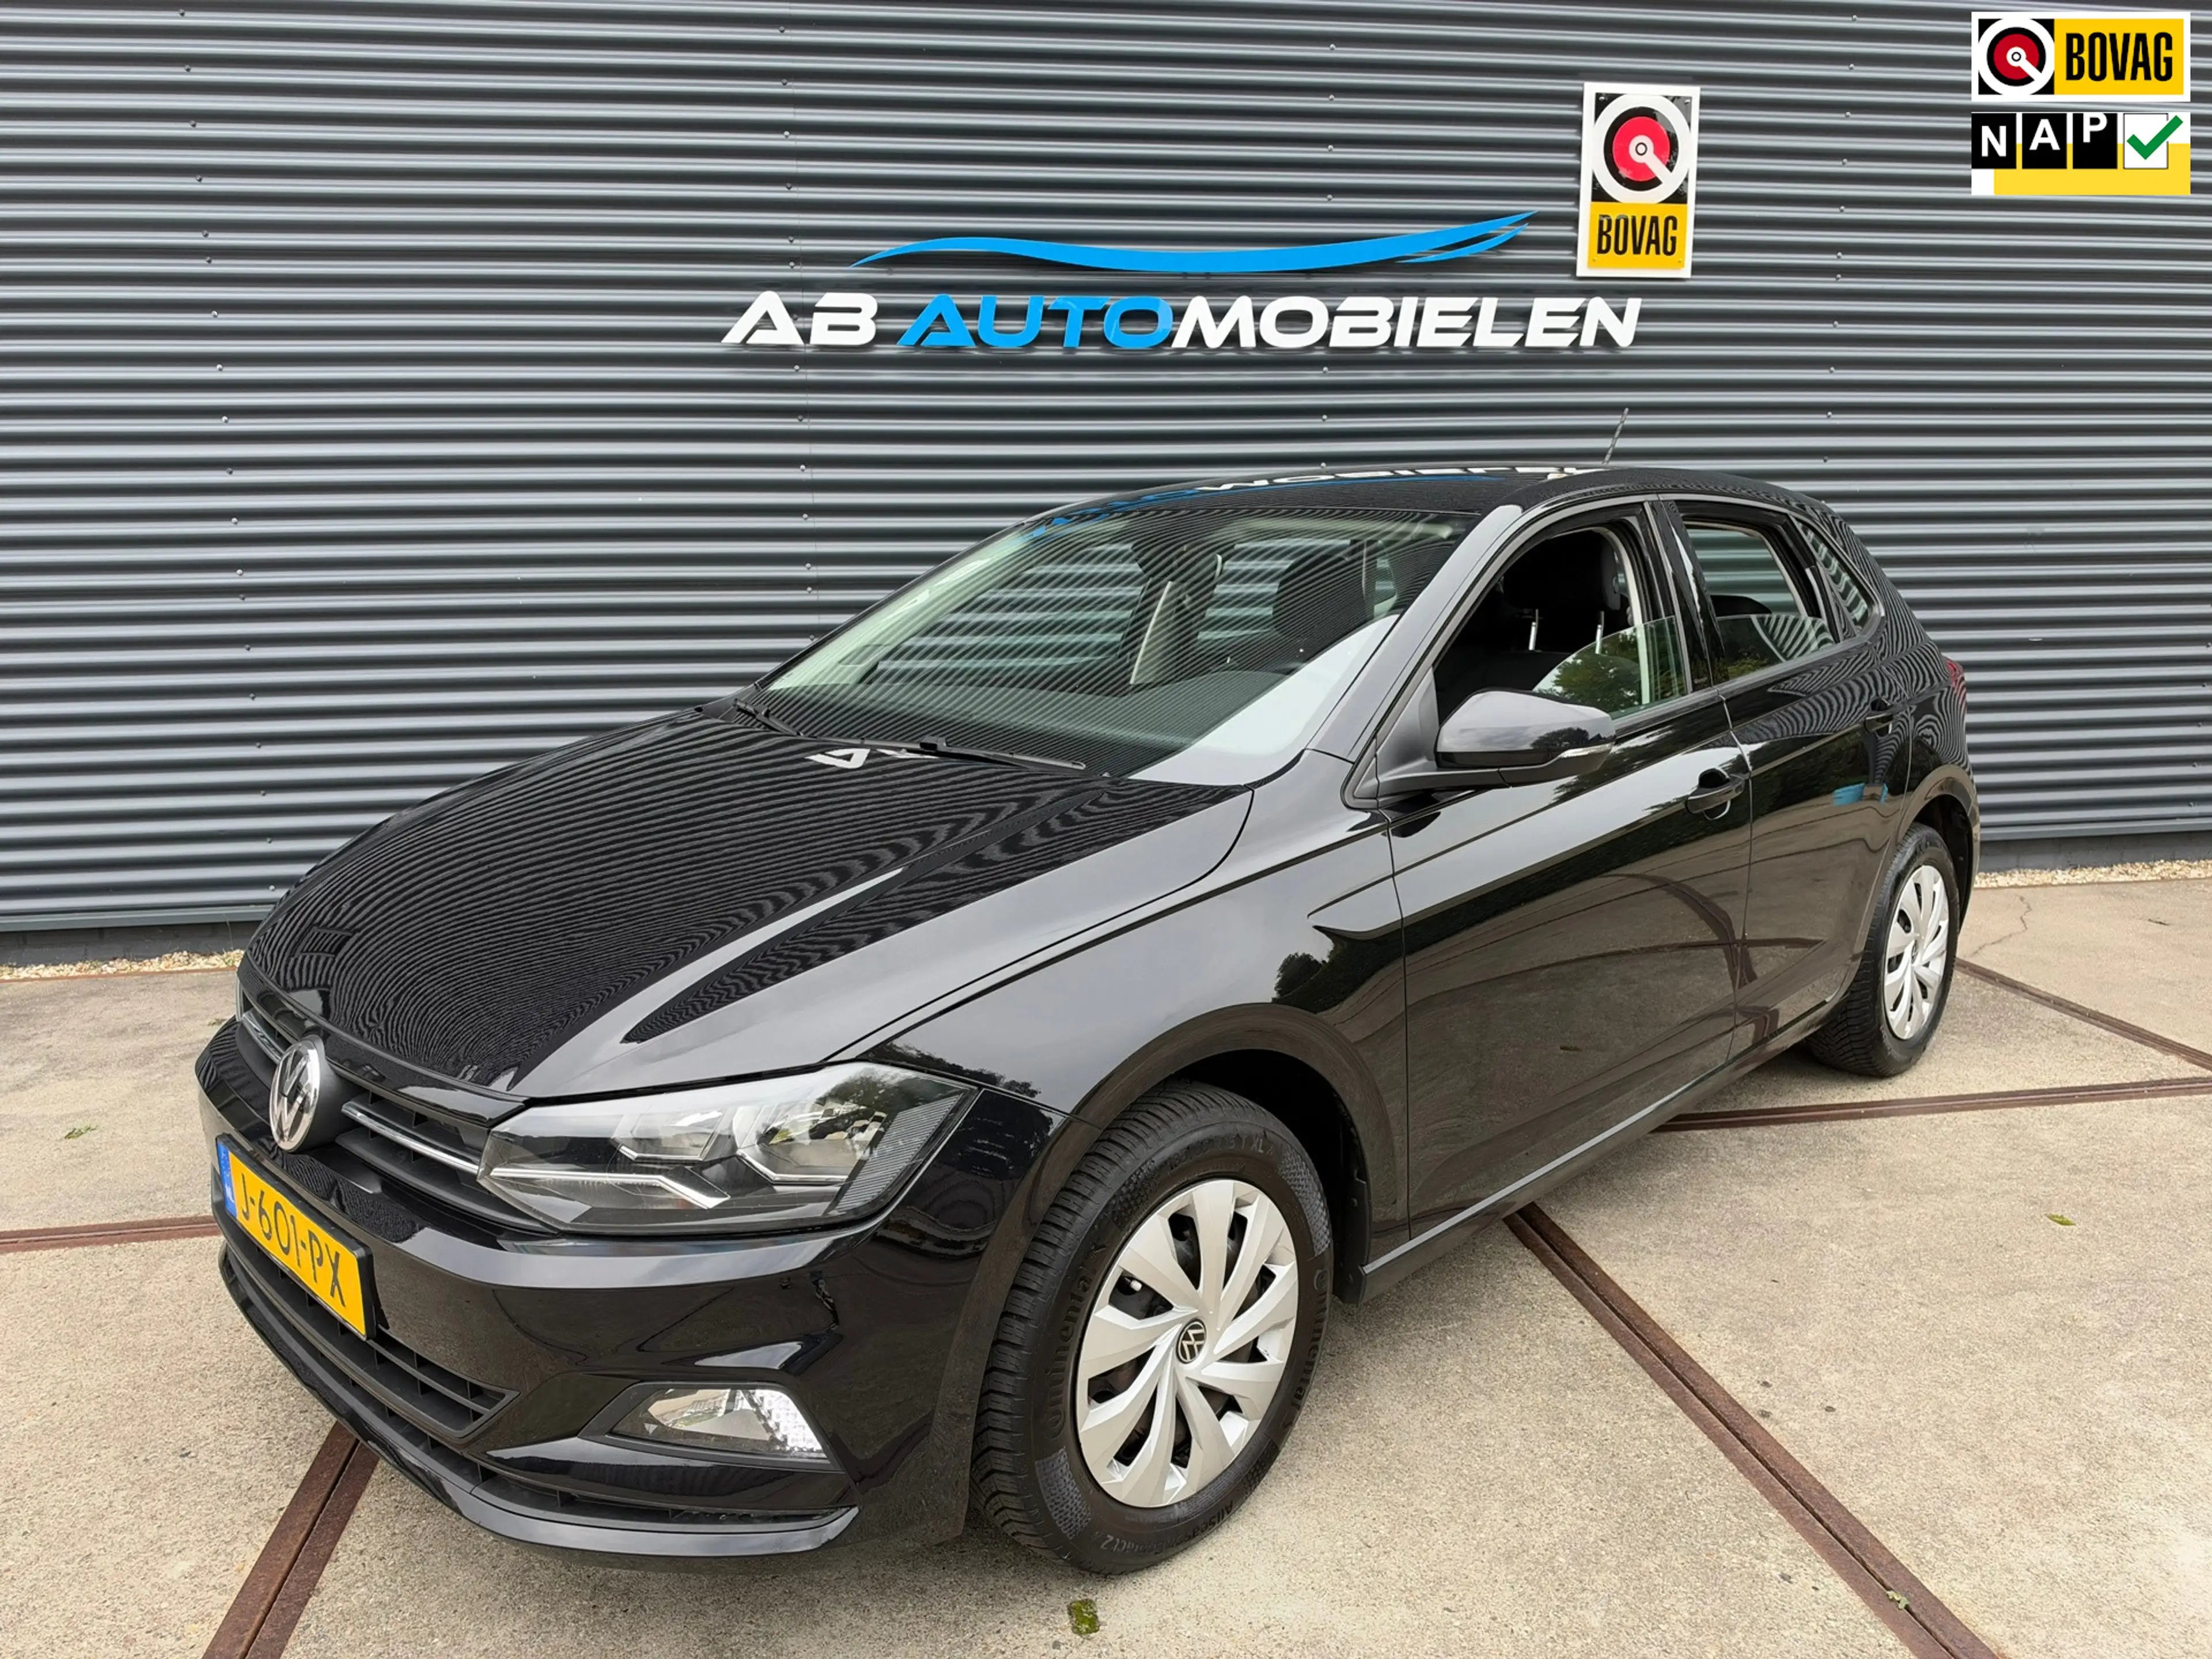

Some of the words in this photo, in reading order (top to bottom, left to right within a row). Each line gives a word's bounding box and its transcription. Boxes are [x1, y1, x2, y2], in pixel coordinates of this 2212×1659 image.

[1597, 214, 1677, 256] BOVAG
[721, 290, 878, 346] AB
[896, 294, 1642, 348] AUTOMOBIELEN
[241, 1172, 346, 1307] J-601-PX
